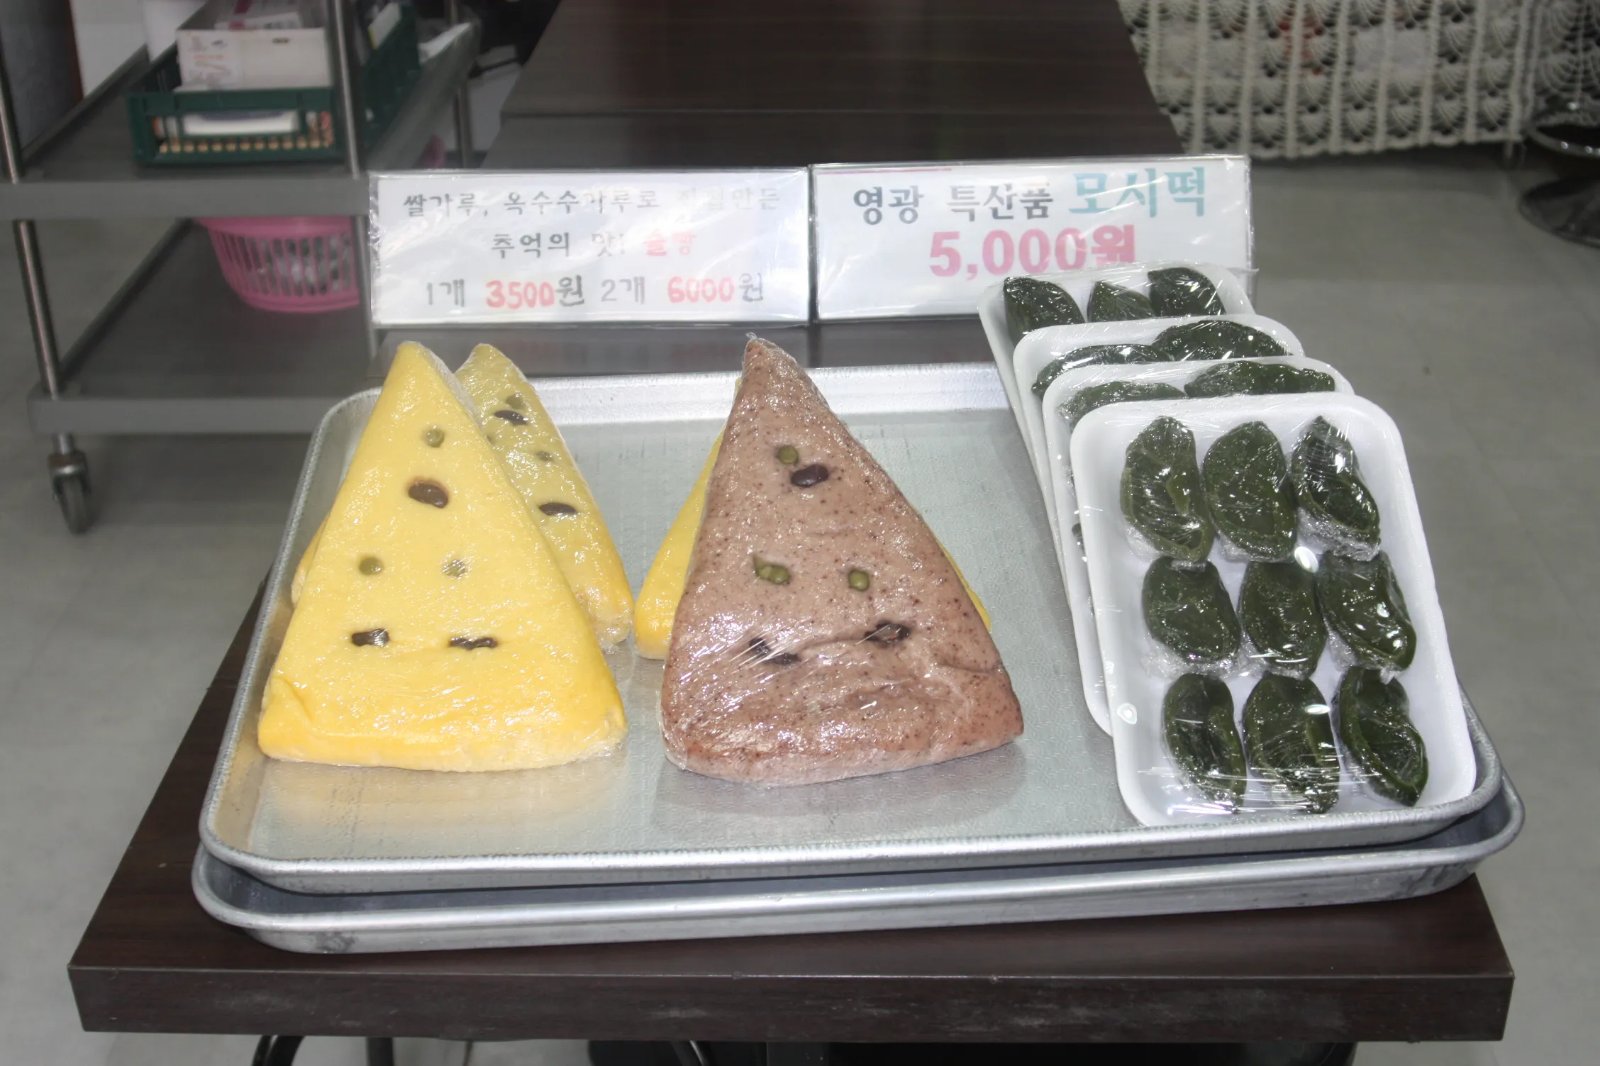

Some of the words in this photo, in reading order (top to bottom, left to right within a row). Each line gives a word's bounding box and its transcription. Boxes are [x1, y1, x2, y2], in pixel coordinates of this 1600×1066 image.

[402, 191, 489, 218] 쌀가루,
[503, 188, 661, 216] 옥수수가루로
[853, 184, 925, 226] 영광
[946, 182, 1054, 221] 특산품
[1069, 166, 1206, 218] 모시떡
[491, 231, 571, 259] 추억의
[929, 223, 1137, 281] 5,000원
[425, 278, 466, 308] 1개
[485, 274, 586, 308] 3500원
[600, 277, 647, 305] 2개
[667, 272, 764, 303] 6000원
